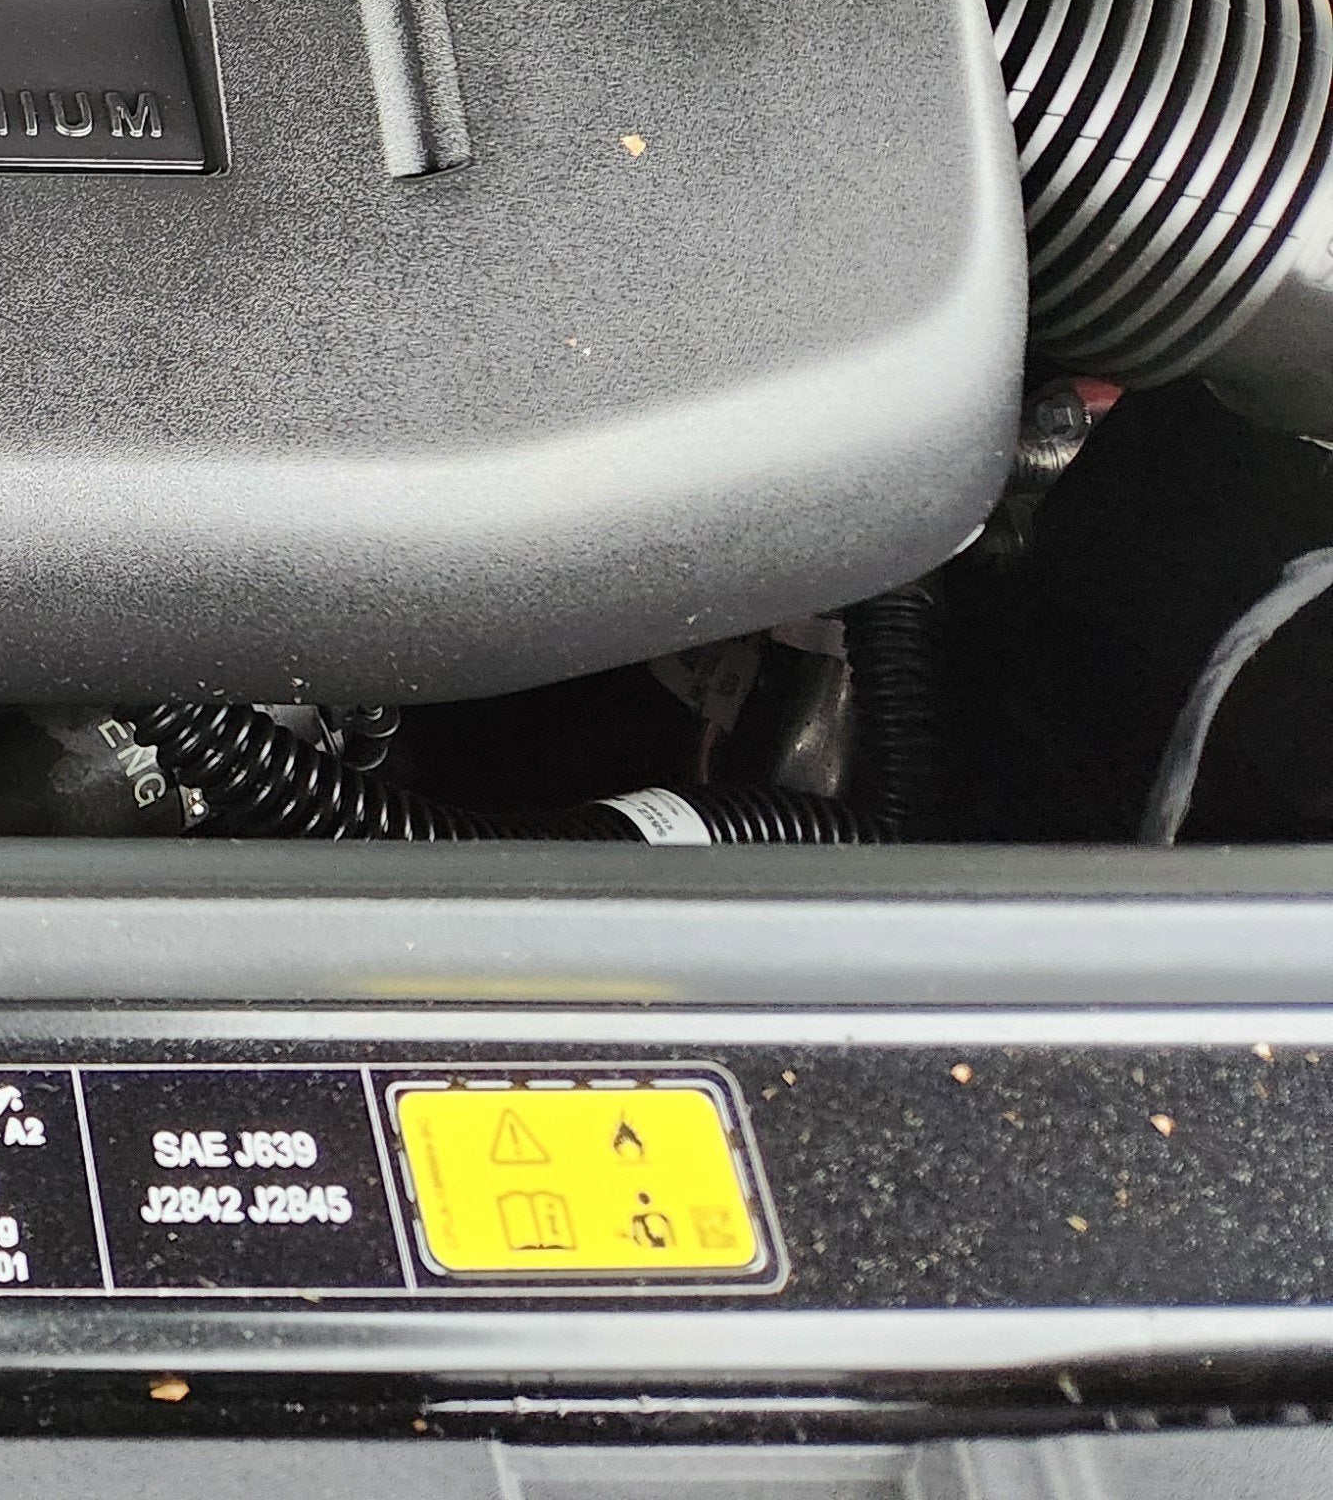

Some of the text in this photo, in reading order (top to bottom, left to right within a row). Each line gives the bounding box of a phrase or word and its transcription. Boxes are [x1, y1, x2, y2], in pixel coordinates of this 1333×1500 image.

[3, 1116, 47, 1146] A2
[152, 1130, 318, 1169] SAE J639
[140, 1185, 353, 1224] J2842 J2845
